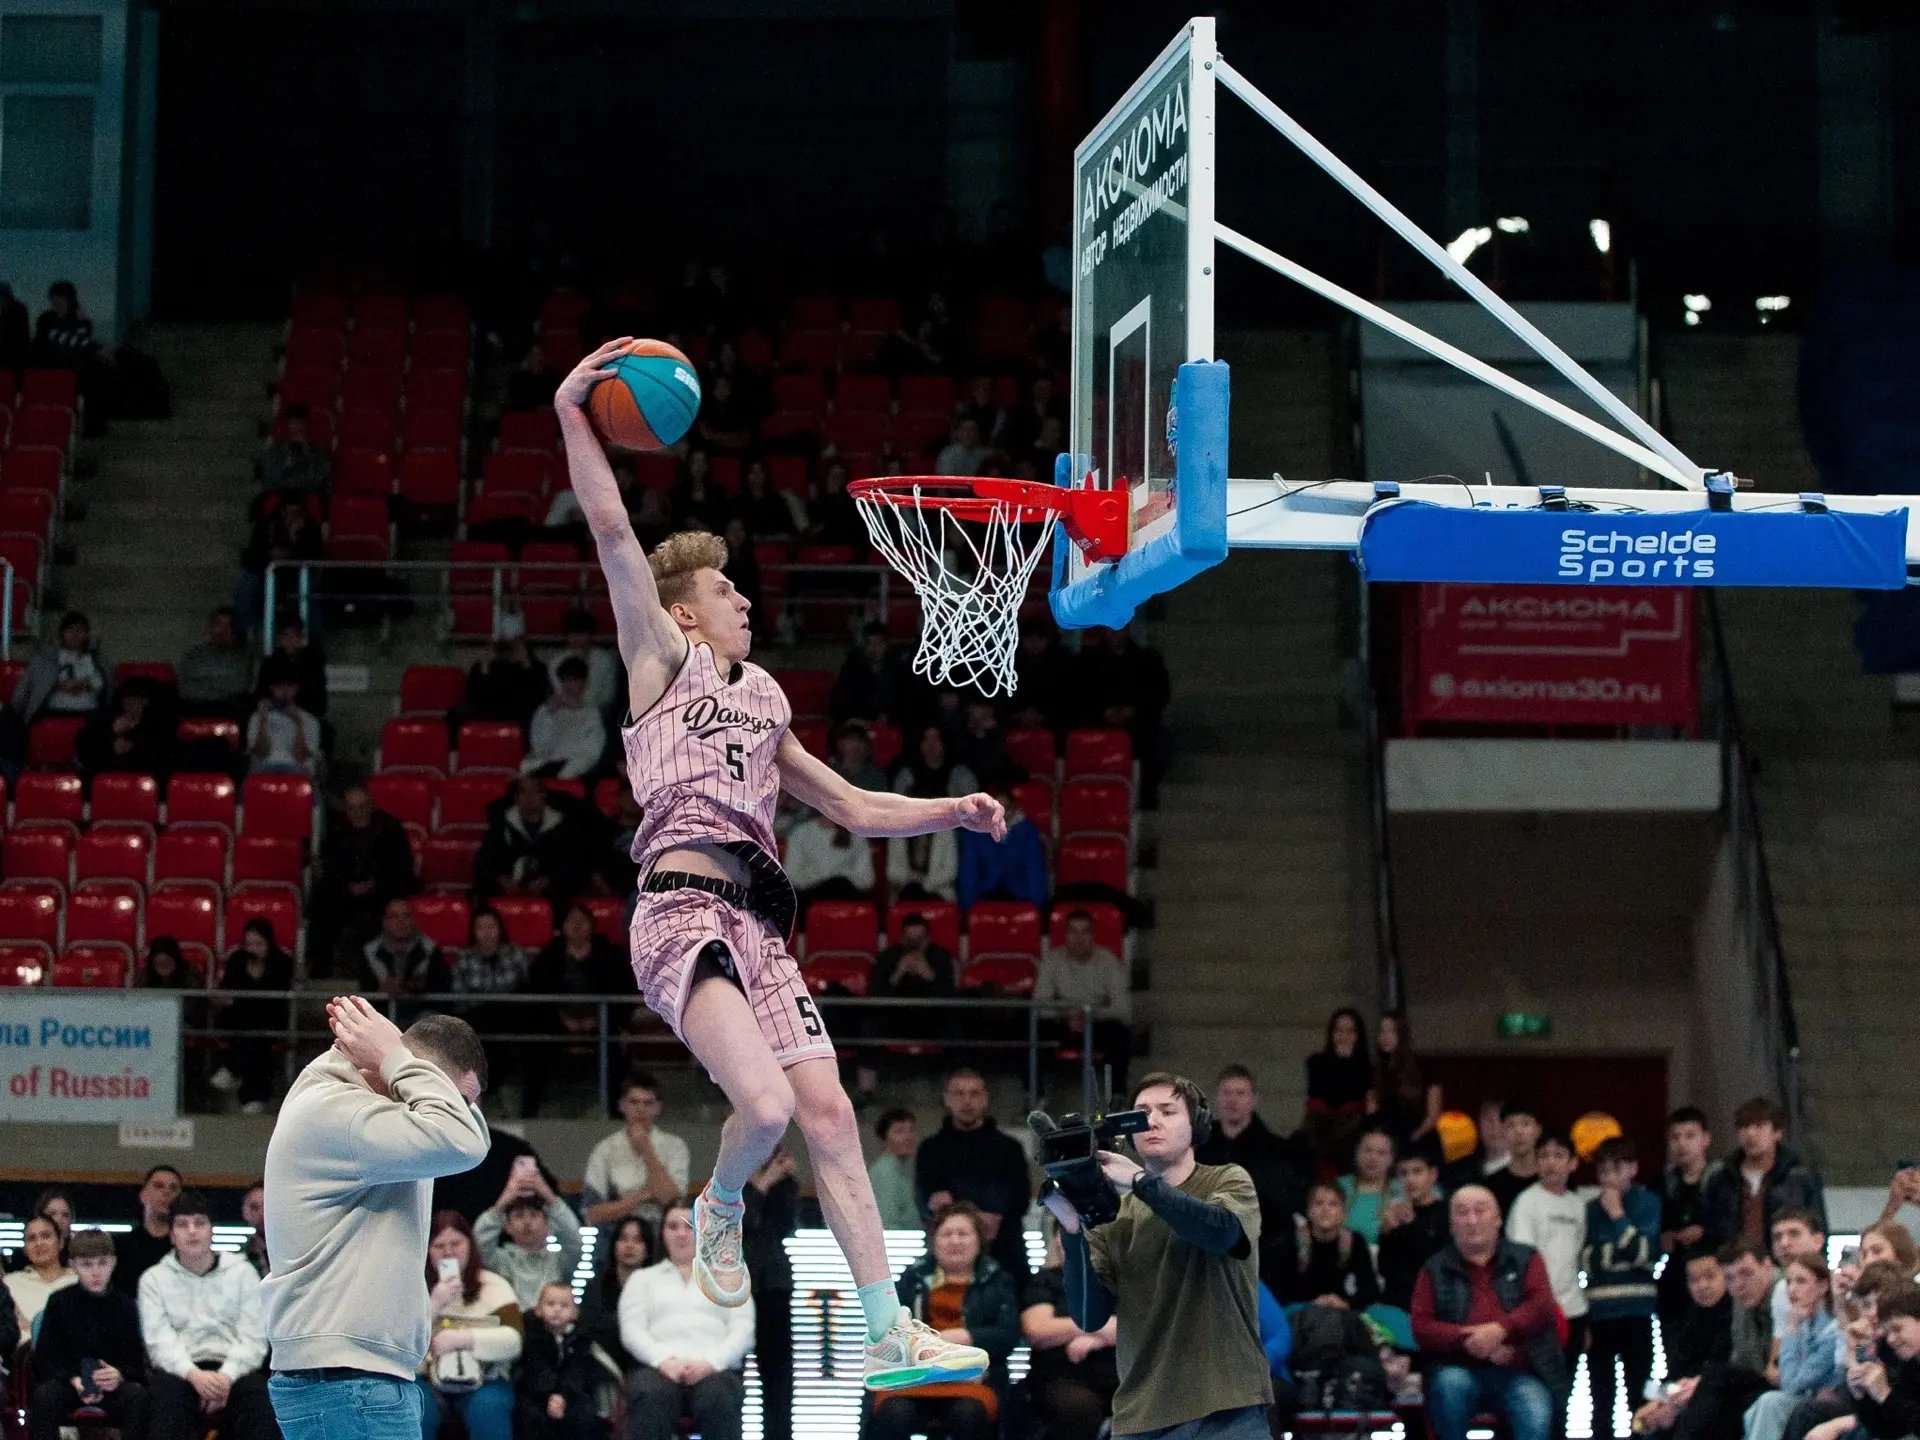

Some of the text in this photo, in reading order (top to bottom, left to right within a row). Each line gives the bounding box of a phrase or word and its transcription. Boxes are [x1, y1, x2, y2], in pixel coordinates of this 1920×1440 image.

[1082, 82, 1187, 233] АКСИОМА
[1080, 152, 1187, 280] АВТОР НЕДВИЖИМОСТИ
[1560, 529, 1716, 554] Schelde
[1558, 554, 1715, 582] Sports
[40, 1017, 151, 1048] России
[794, 995, 823, 1037] 5
[9, 1064, 149, 1098] of Russia
